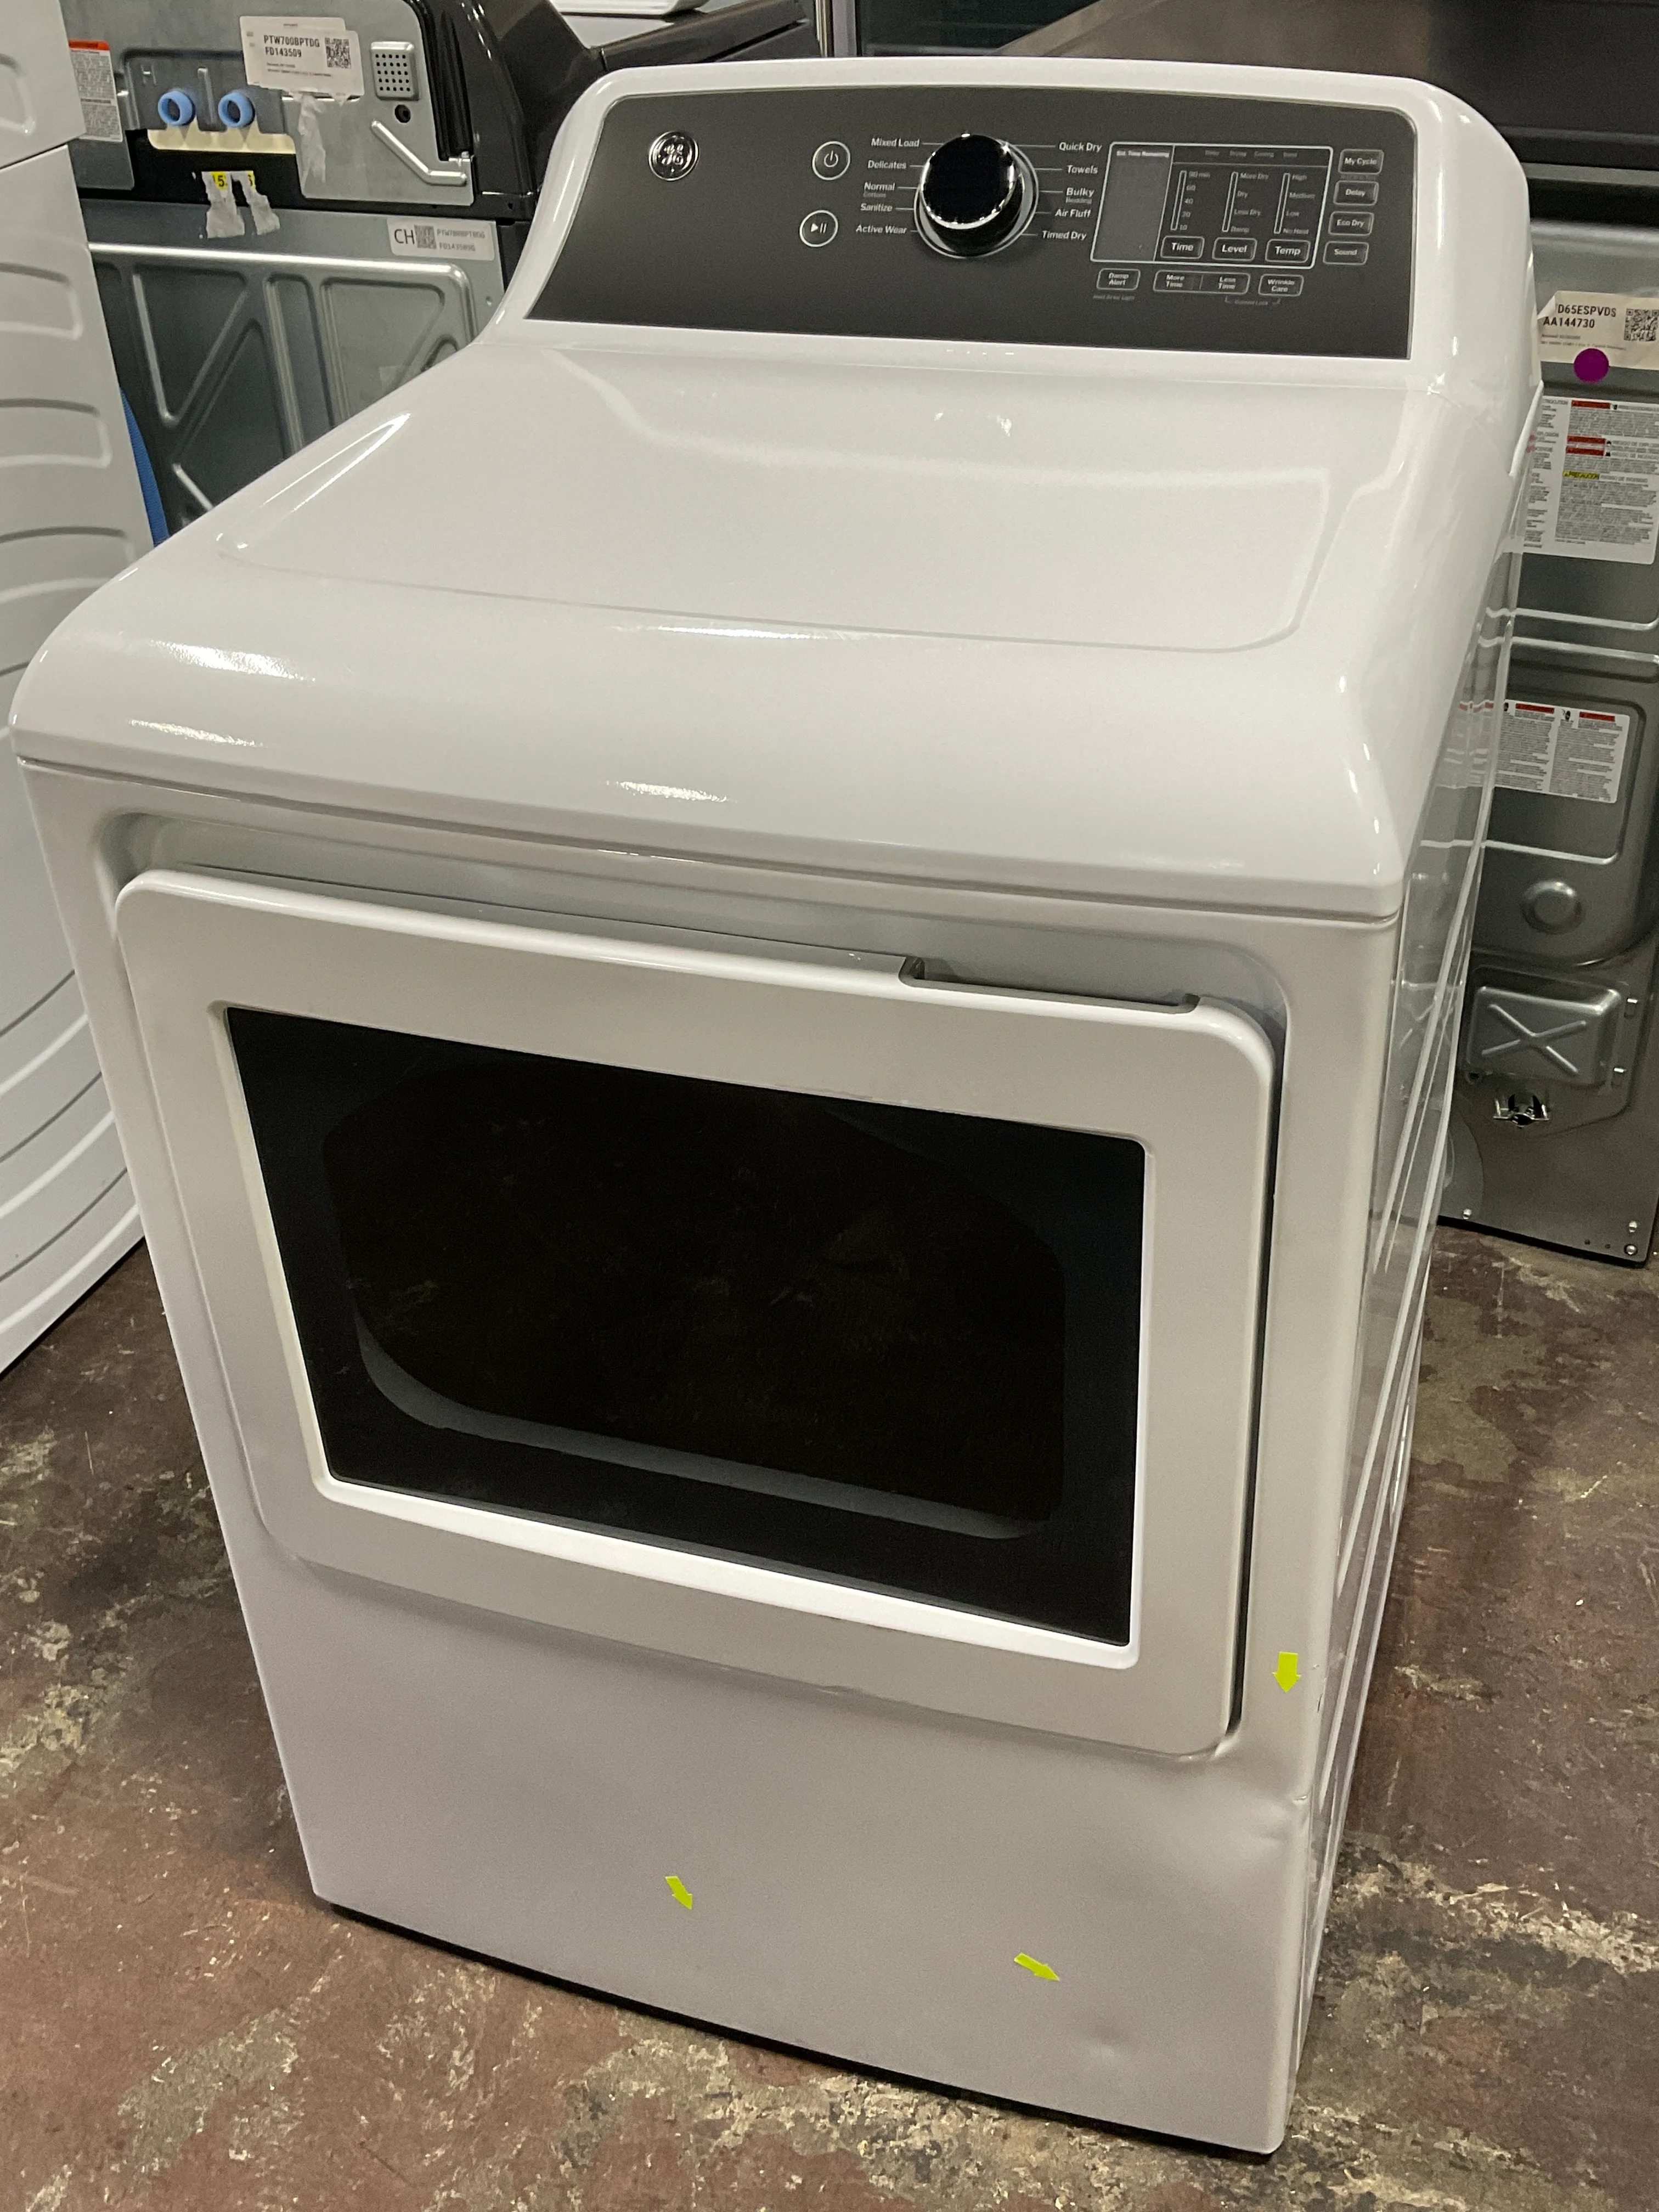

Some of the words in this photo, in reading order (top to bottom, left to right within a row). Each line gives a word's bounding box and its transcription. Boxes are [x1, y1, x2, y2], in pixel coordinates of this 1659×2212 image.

[871, 138, 896, 147] Mixed
[899, 138, 920, 148] Load
[1059, 142, 1084, 151] Quick
[1086, 142, 1102, 153] Dry
[867, 160, 907, 169] Delicates
[1345, 157, 1356, 166] My
[1357, 157, 1377, 166] Cycle
[1068, 165, 1098, 174] Towels
[864, 182, 895, 191] Normal
[1066, 187, 1094, 197] Bulky
[1345, 188, 1365, 197] Delay
[860, 203, 893, 212] Sanitize
[1055, 208, 1068, 217] Air
[1070, 209, 1091, 218] Fluff
[856, 224, 882, 233] Active
[884, 225, 907, 234] Wear
[394, 229, 415, 245] CH
[1042, 230, 1069, 239] Timed
[1071, 231, 1086, 241] Dry
[1171, 242, 1194, 251] Time
[1222, 245, 1247, 253] Level
[1275, 246, 1301, 256] Temp
[1543, 317, 1595, 329] AA144730
